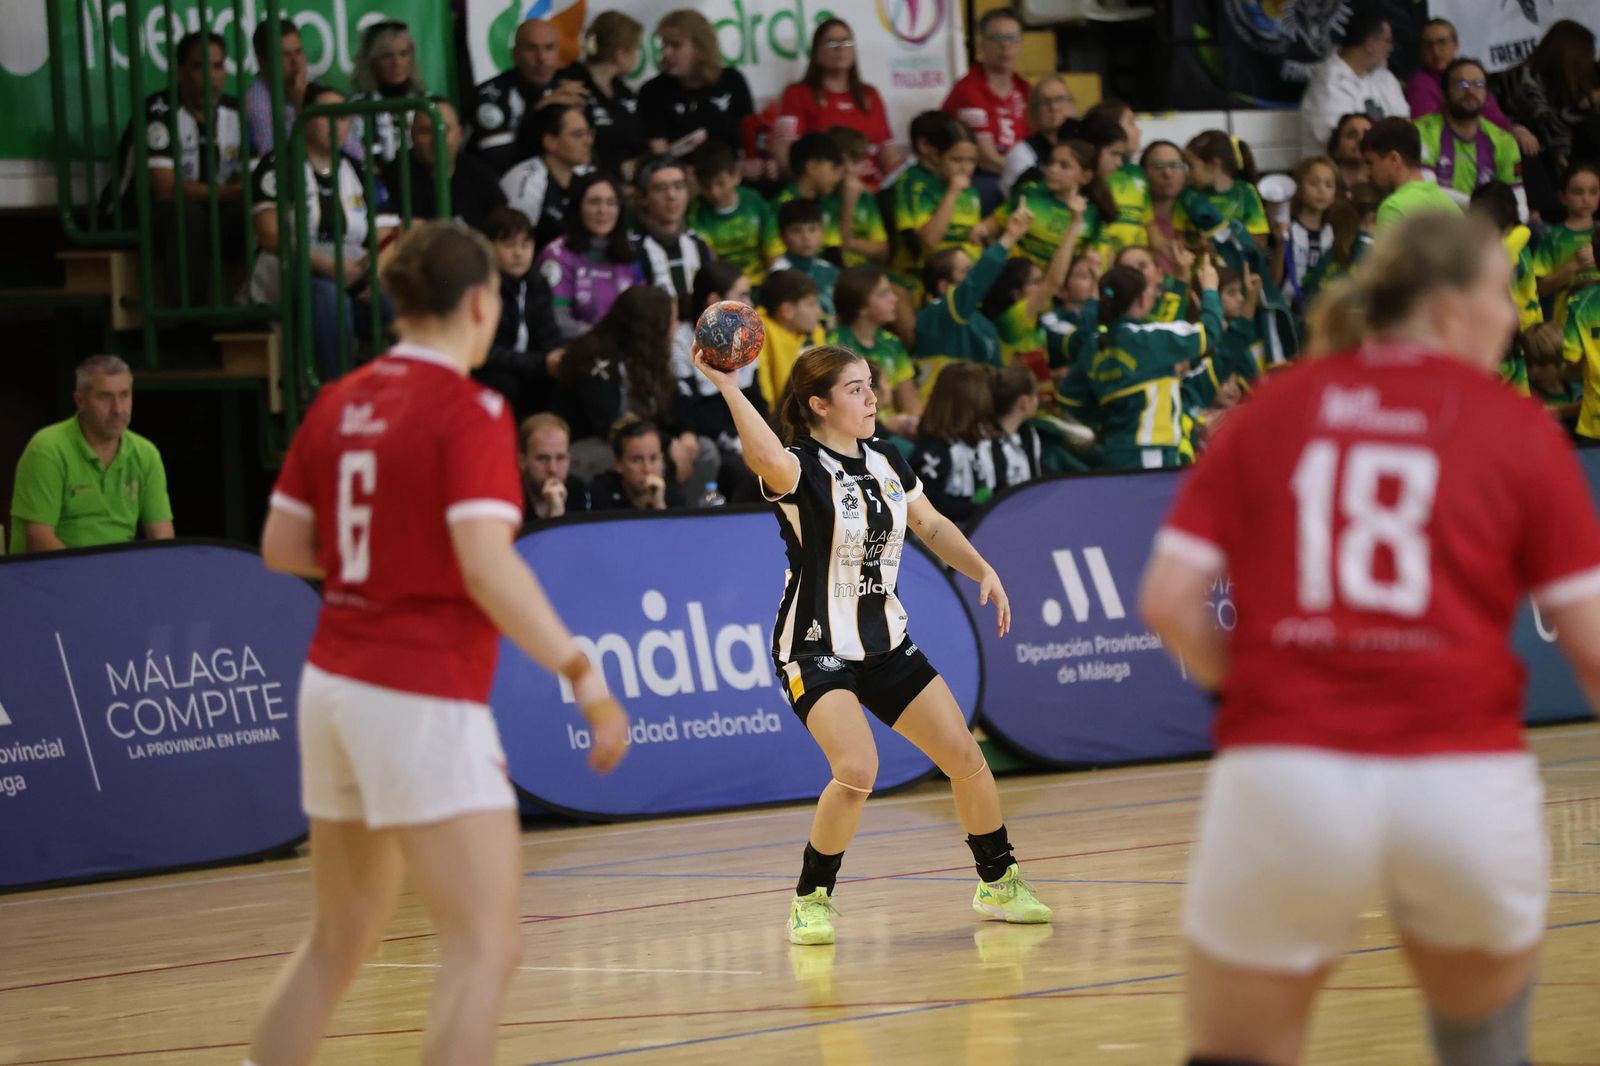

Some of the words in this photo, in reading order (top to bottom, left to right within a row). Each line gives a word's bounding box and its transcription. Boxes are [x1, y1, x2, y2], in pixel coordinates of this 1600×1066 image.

[337, 450, 378, 584] 6
[1290, 436, 1441, 619] 18
[105, 645, 266, 696] MÁLAGA
[1015, 637, 1094, 666] Diputación
[1094, 631, 1163, 655] Provincial
[1057, 663, 1077, 684] de
[1078, 659, 1131, 683] Málaga
[106, 682, 288, 739] COMPITE
[567, 723, 591, 751] la
[682, 707, 782, 740] redonda
[127, 743, 146, 760] LA
[147, 734, 216, 758] PROVINCIA
[217, 732, 235, 748] EN
[236, 727, 281, 746] FORMA
